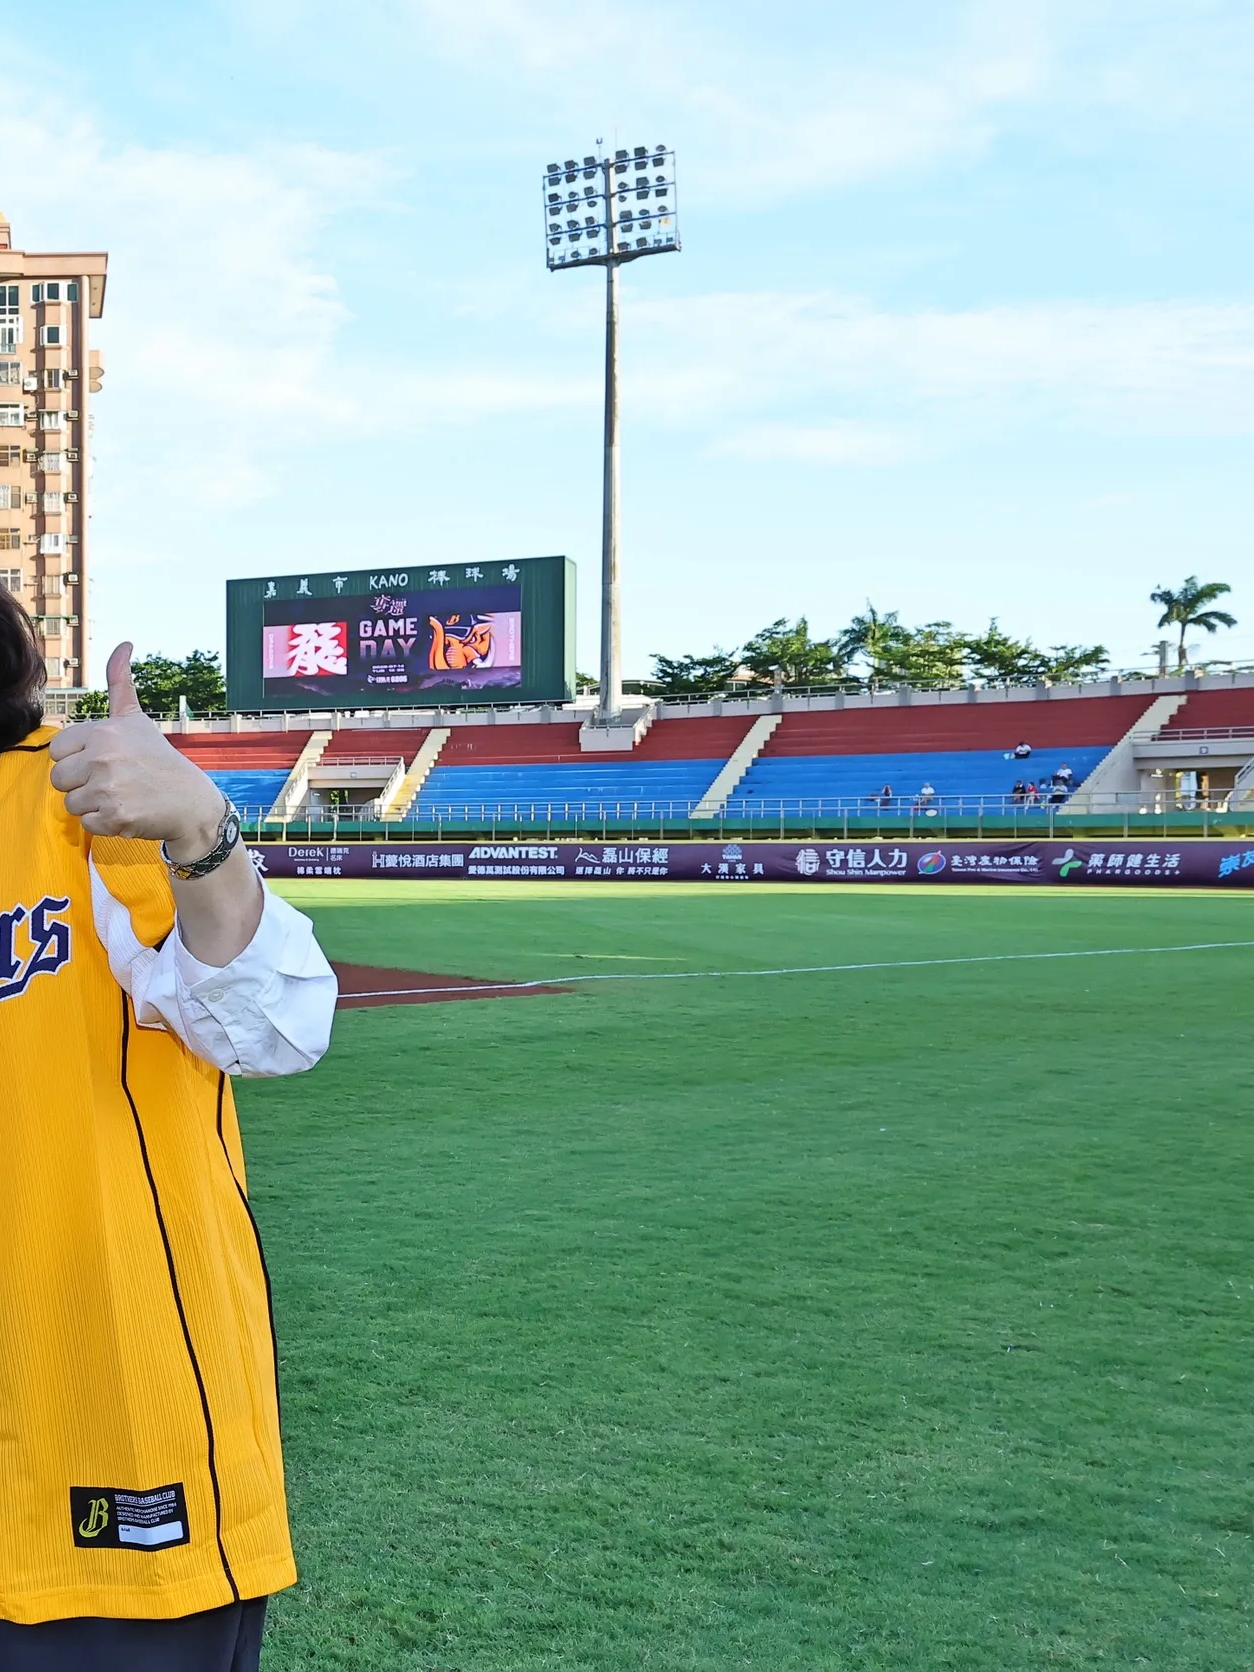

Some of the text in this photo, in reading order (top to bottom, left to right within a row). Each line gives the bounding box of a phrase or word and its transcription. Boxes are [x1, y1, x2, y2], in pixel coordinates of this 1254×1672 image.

[369, 572, 409, 590] KANO
[359, 617, 418, 638] GAME
[359, 638, 417, 659] DAY
[468, 846, 558, 859] ADVANTEST
[602, 847, 668, 864] 磊山保經
[826, 848, 907, 868] 守信人力
[1088, 853, 1180, 868] 藥師健生活
[826, 868, 845, 876] Shou
[866, 869, 906, 877] Manpower
[162, 1490, 176, 1500] CLUB
